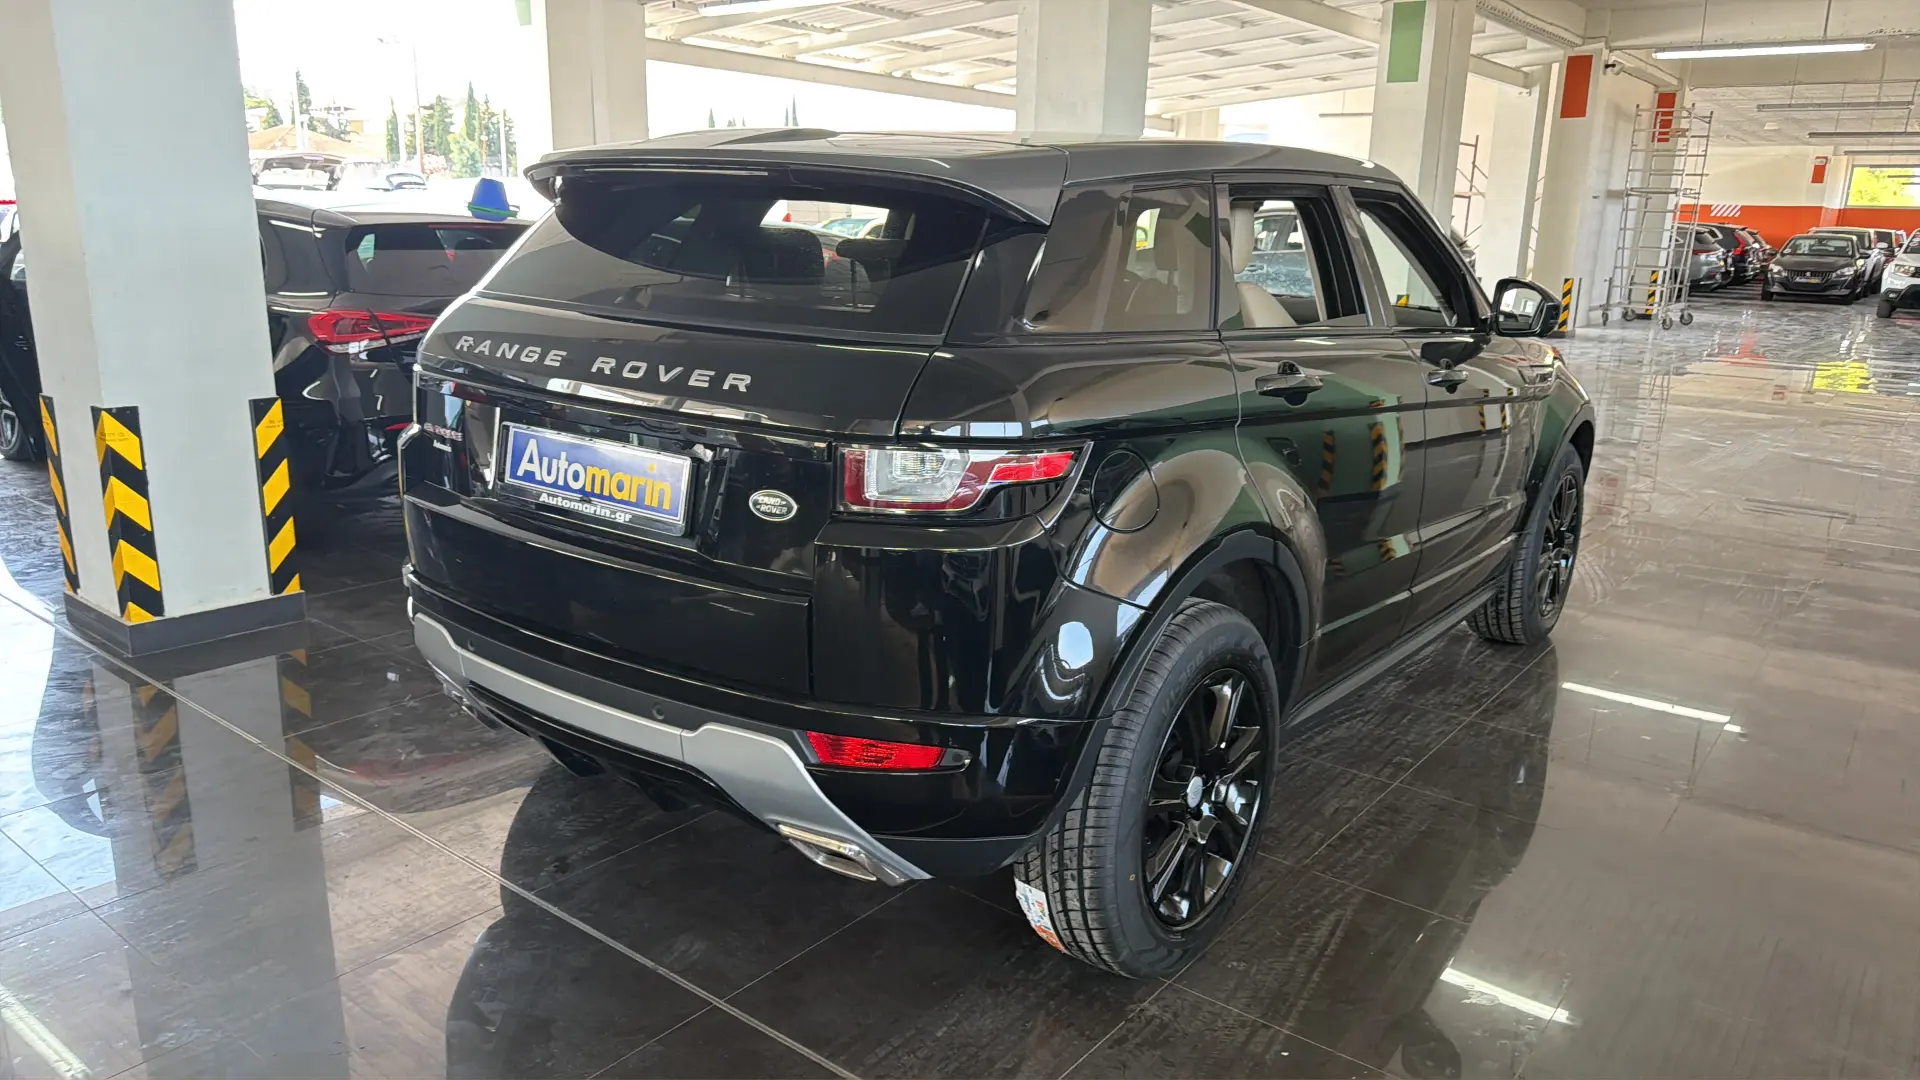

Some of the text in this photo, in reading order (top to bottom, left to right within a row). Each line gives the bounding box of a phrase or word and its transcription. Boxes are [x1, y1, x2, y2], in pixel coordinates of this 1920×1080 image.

[455, 336, 751, 392] RANGE ROVER
[516, 438, 672, 510] Automarin
[539, 493, 632, 522] Automarin.gr
[760, 504, 787, 514] ROVER
